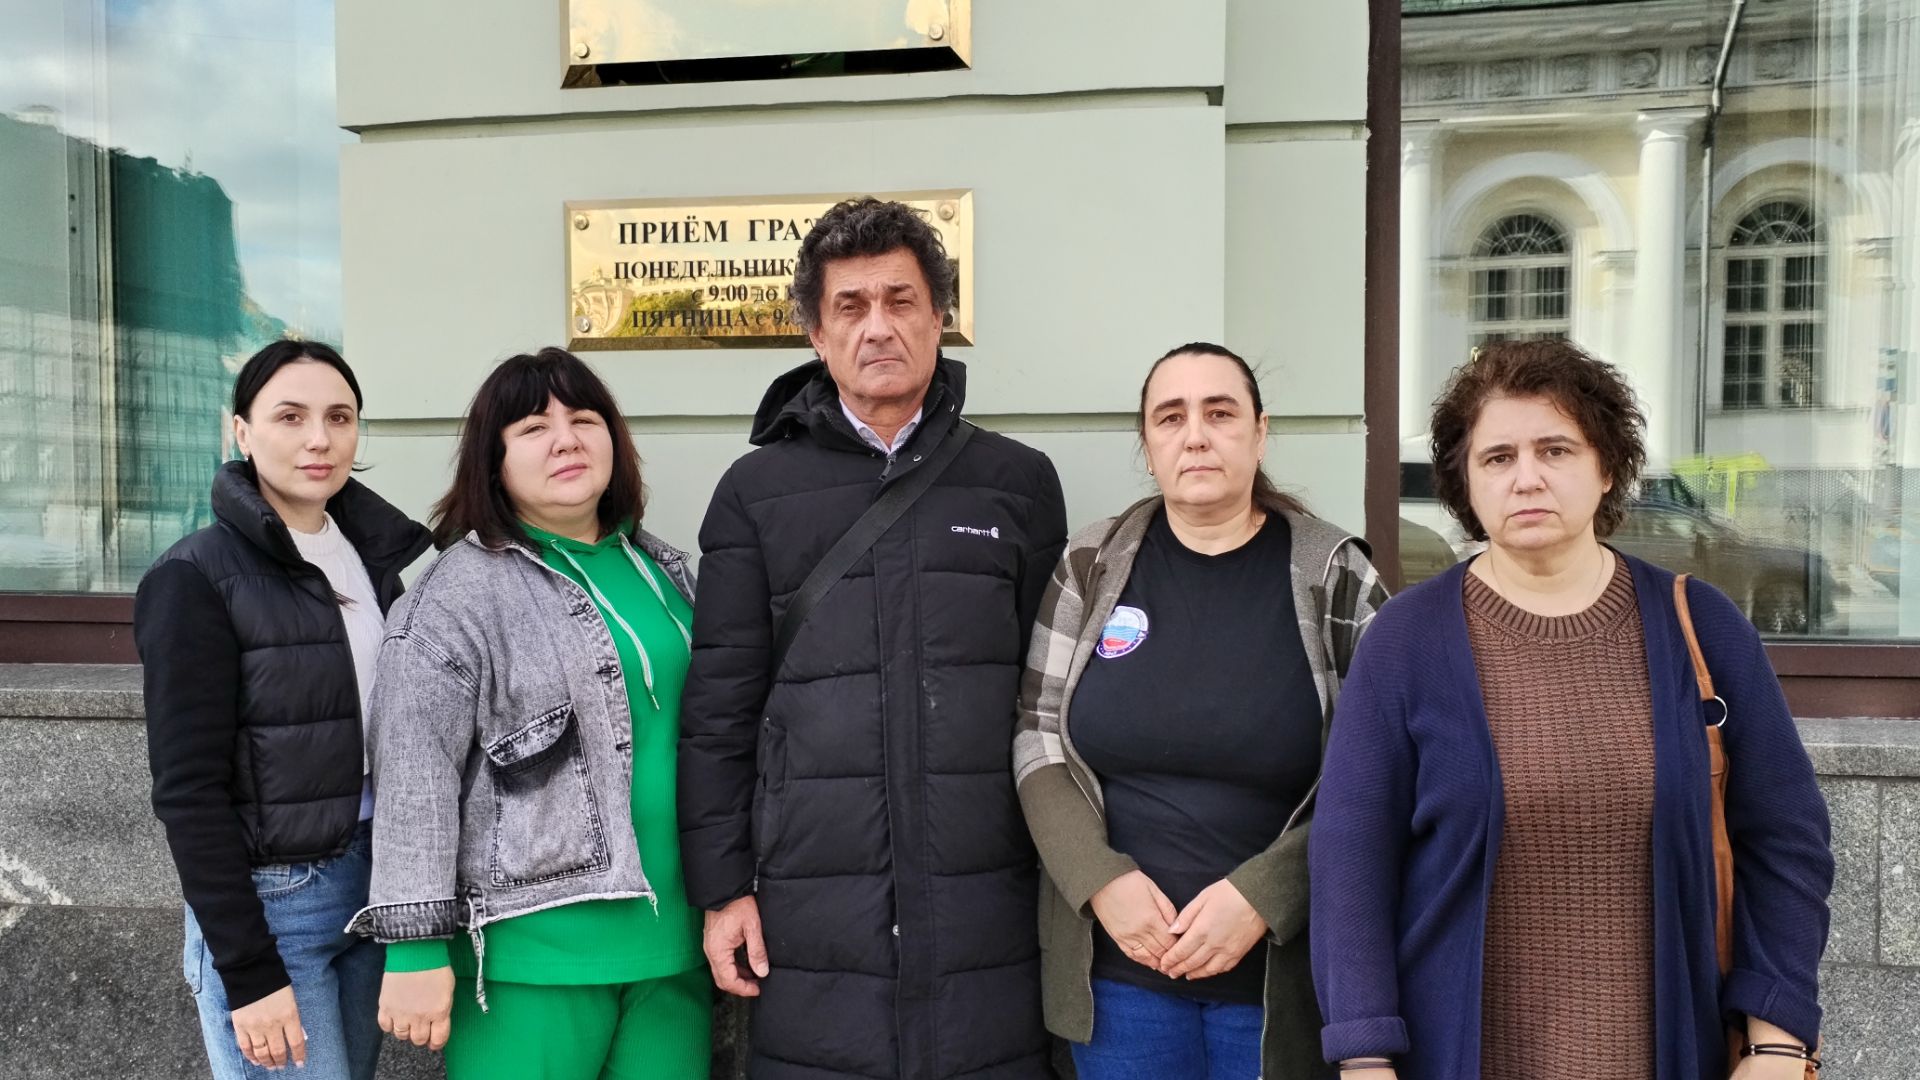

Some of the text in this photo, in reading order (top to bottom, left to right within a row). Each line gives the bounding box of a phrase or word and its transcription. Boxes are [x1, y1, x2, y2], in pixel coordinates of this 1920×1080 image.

[618, 216, 728, 244] ПРИЁМ
[614, 258, 794, 281] ПОНЕДЕЛЬНИК
[709, 284, 748, 302] 9.00
[755, 289, 778, 303] до
[633, 309, 789, 329] ПЯТНИЦА с 9.
[951, 525, 991, 537] carhartt
